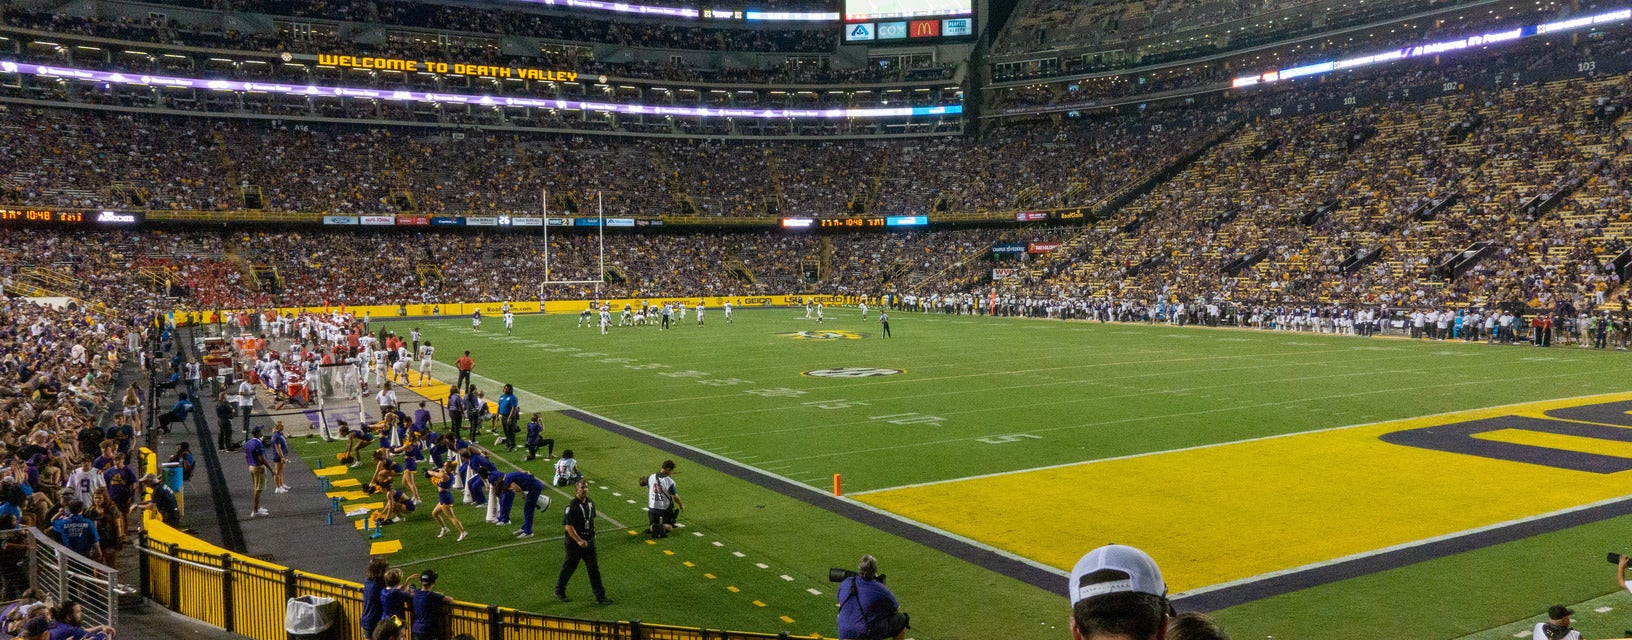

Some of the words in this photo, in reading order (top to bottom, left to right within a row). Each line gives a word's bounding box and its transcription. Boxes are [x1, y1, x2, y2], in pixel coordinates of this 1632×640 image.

[879, 25, 905, 35] COX
[318, 54, 417, 72] WELCOME
[424, 61, 448, 73] TO
[455, 63, 511, 78] DEATH
[517, 68, 577, 82] VALLEY
[1578, 61, 1596, 71] 103
[1443, 81, 1457, 91] 102
[1343, 97, 1356, 105] 101
[1269, 108, 1282, 116] 100
[26, 210, 51, 220] 10:48
[498, 216, 510, 225] 26
[845, 218, 863, 226] 10:48
[975, 433, 1043, 444] 5
[80, 478, 91, 493] 9
